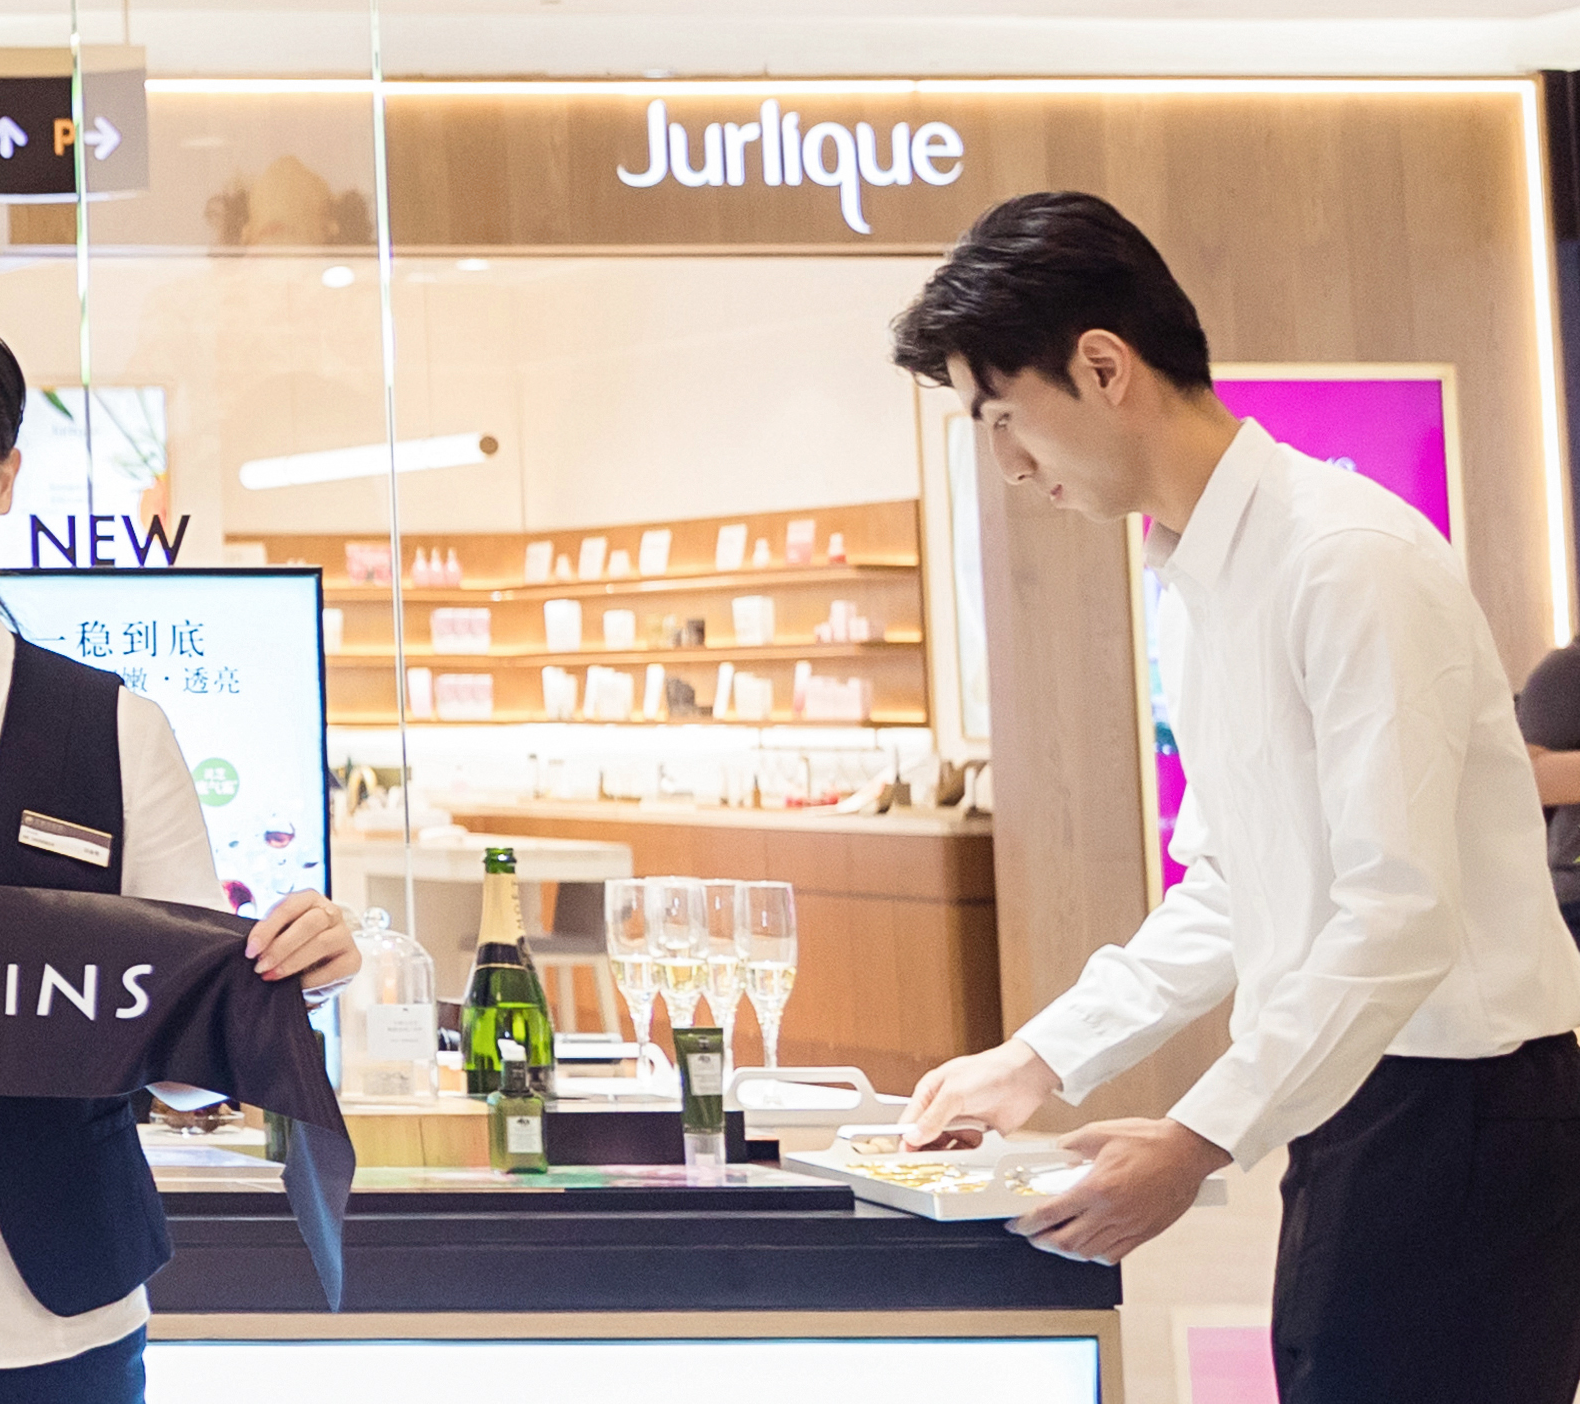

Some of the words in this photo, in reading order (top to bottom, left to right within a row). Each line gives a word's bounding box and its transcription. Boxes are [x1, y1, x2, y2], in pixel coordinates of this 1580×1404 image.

[618, 98, 963, 234] Jurlique
[29, 514, 192, 567] NEW
[30, 619, 206, 659] 一稳到底
